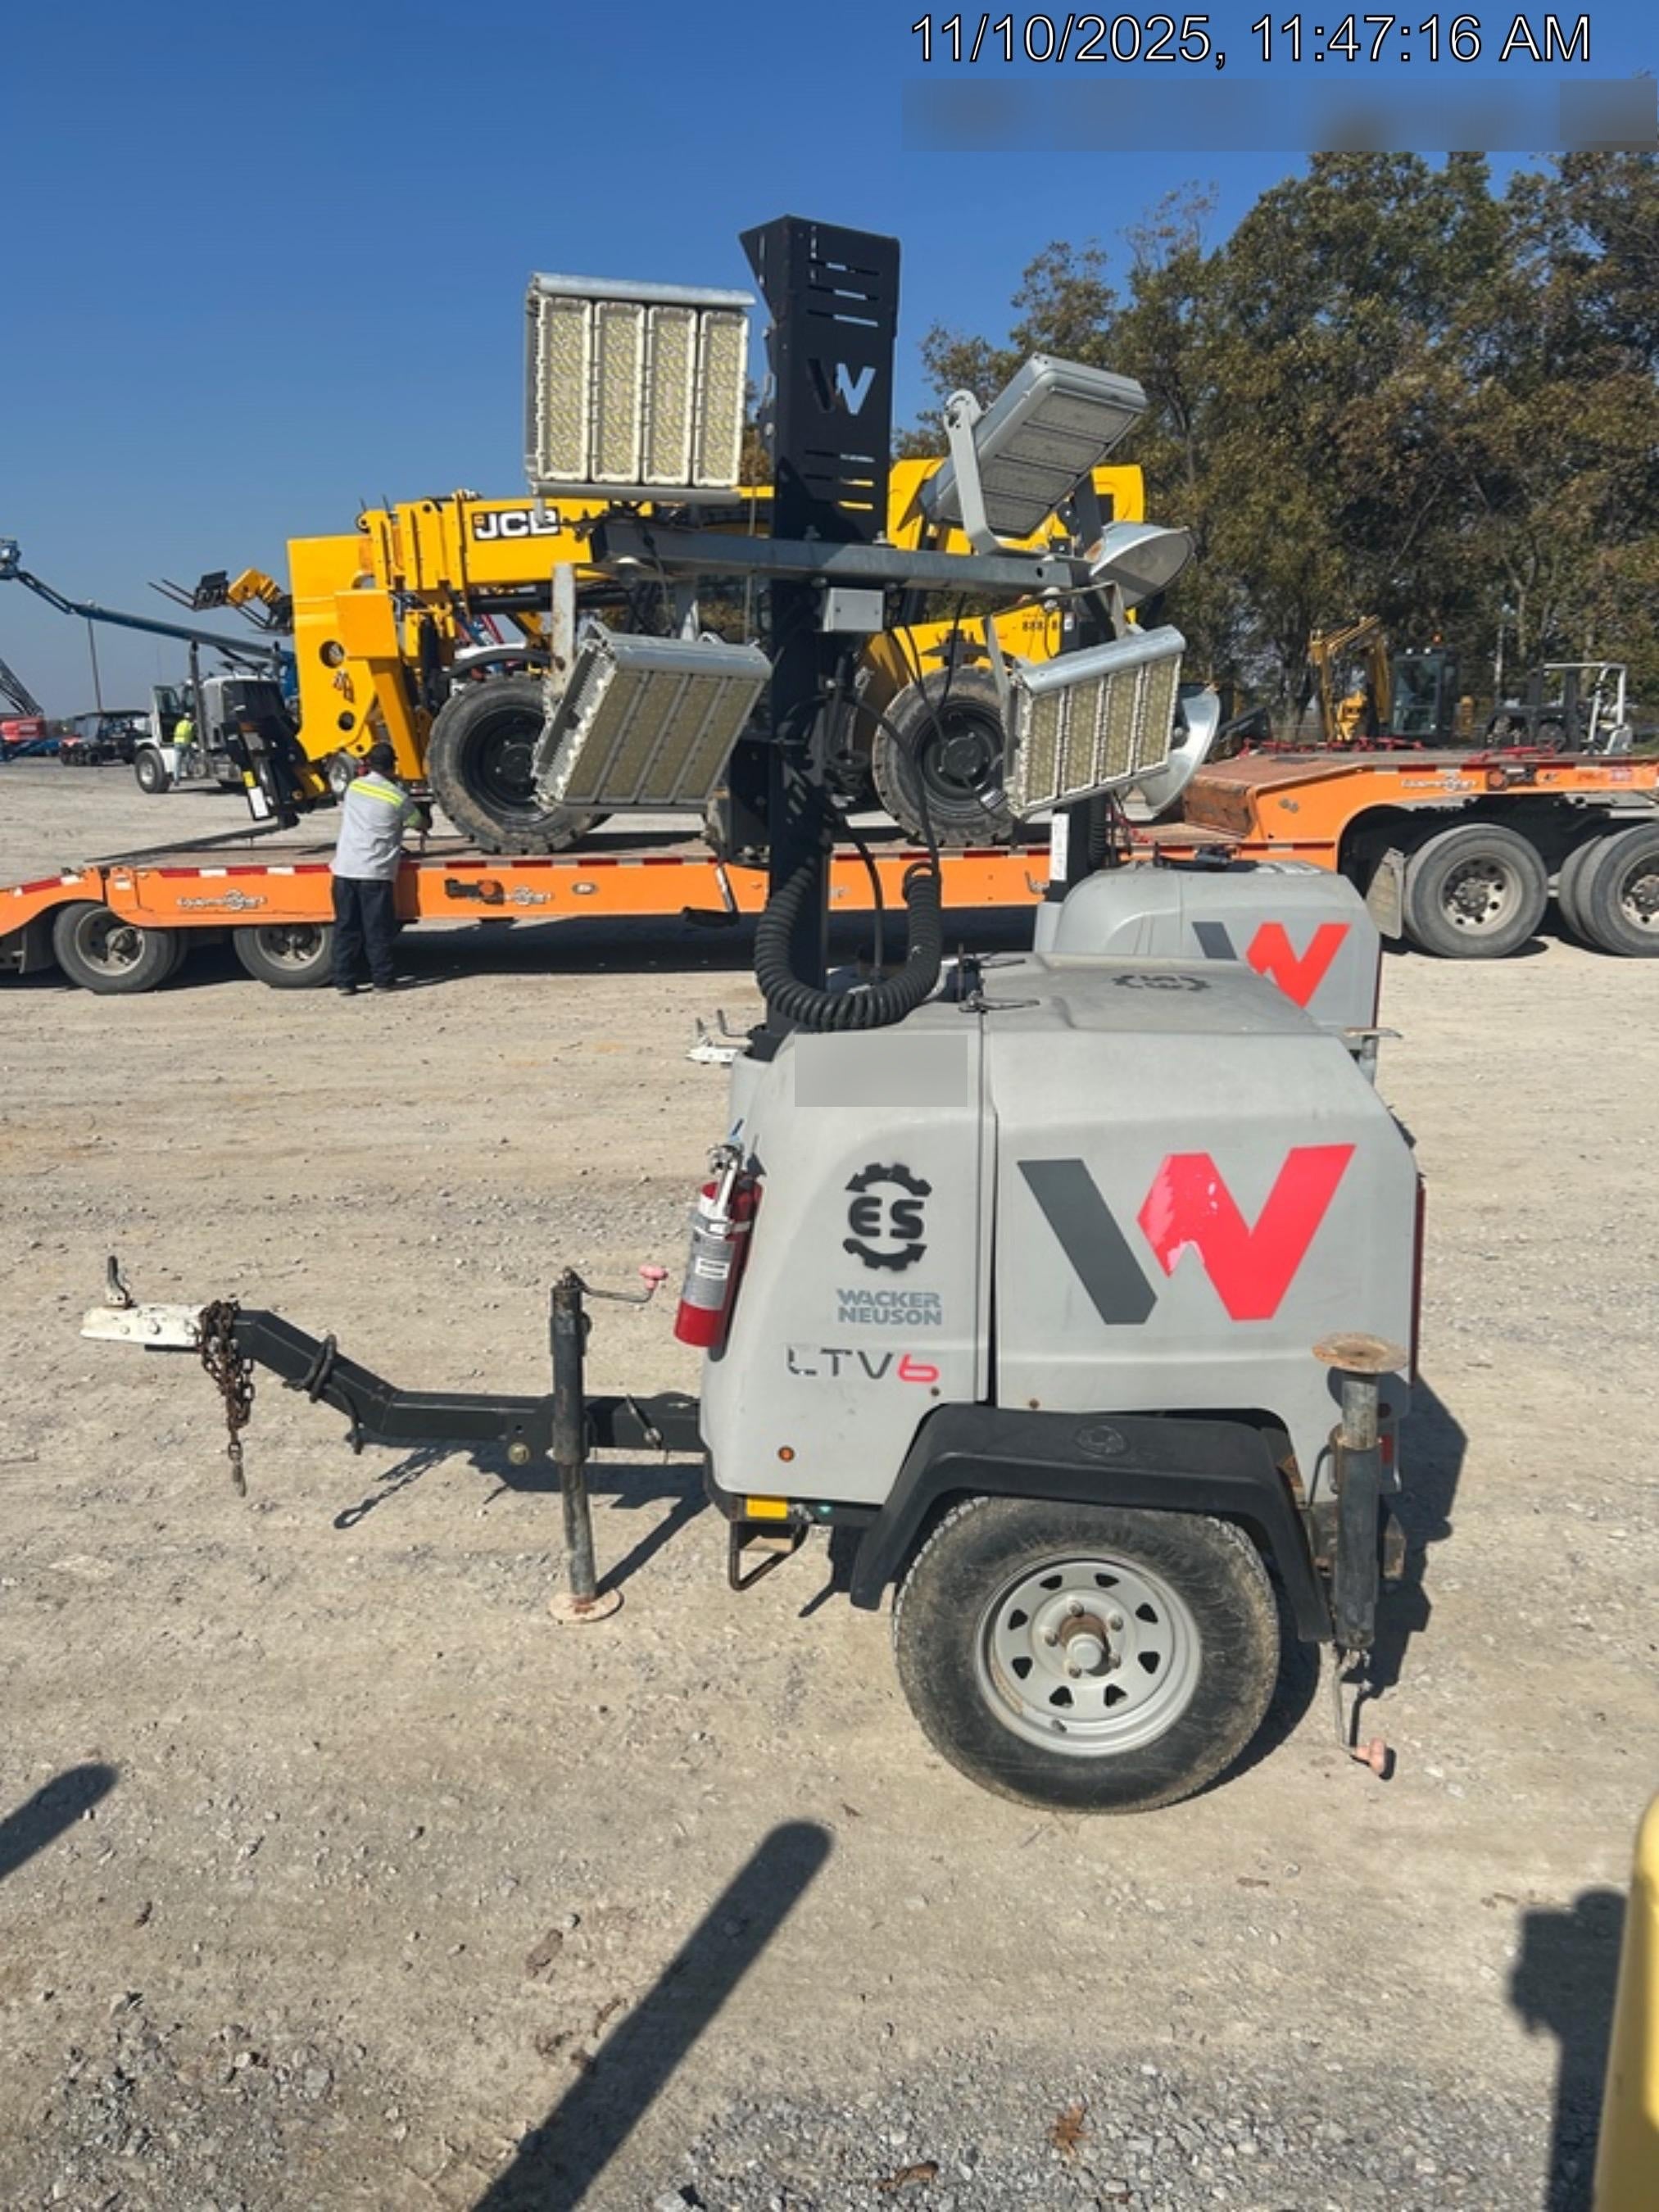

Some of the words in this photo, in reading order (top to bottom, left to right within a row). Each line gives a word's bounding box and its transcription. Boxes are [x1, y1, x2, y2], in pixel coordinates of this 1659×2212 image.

[848, 1196, 924, 1240] ES
[837, 1289, 941, 1308] WACKER
[838, 1308, 941, 1326] NEUSON
[787, 1348, 939, 1383] LTV6
